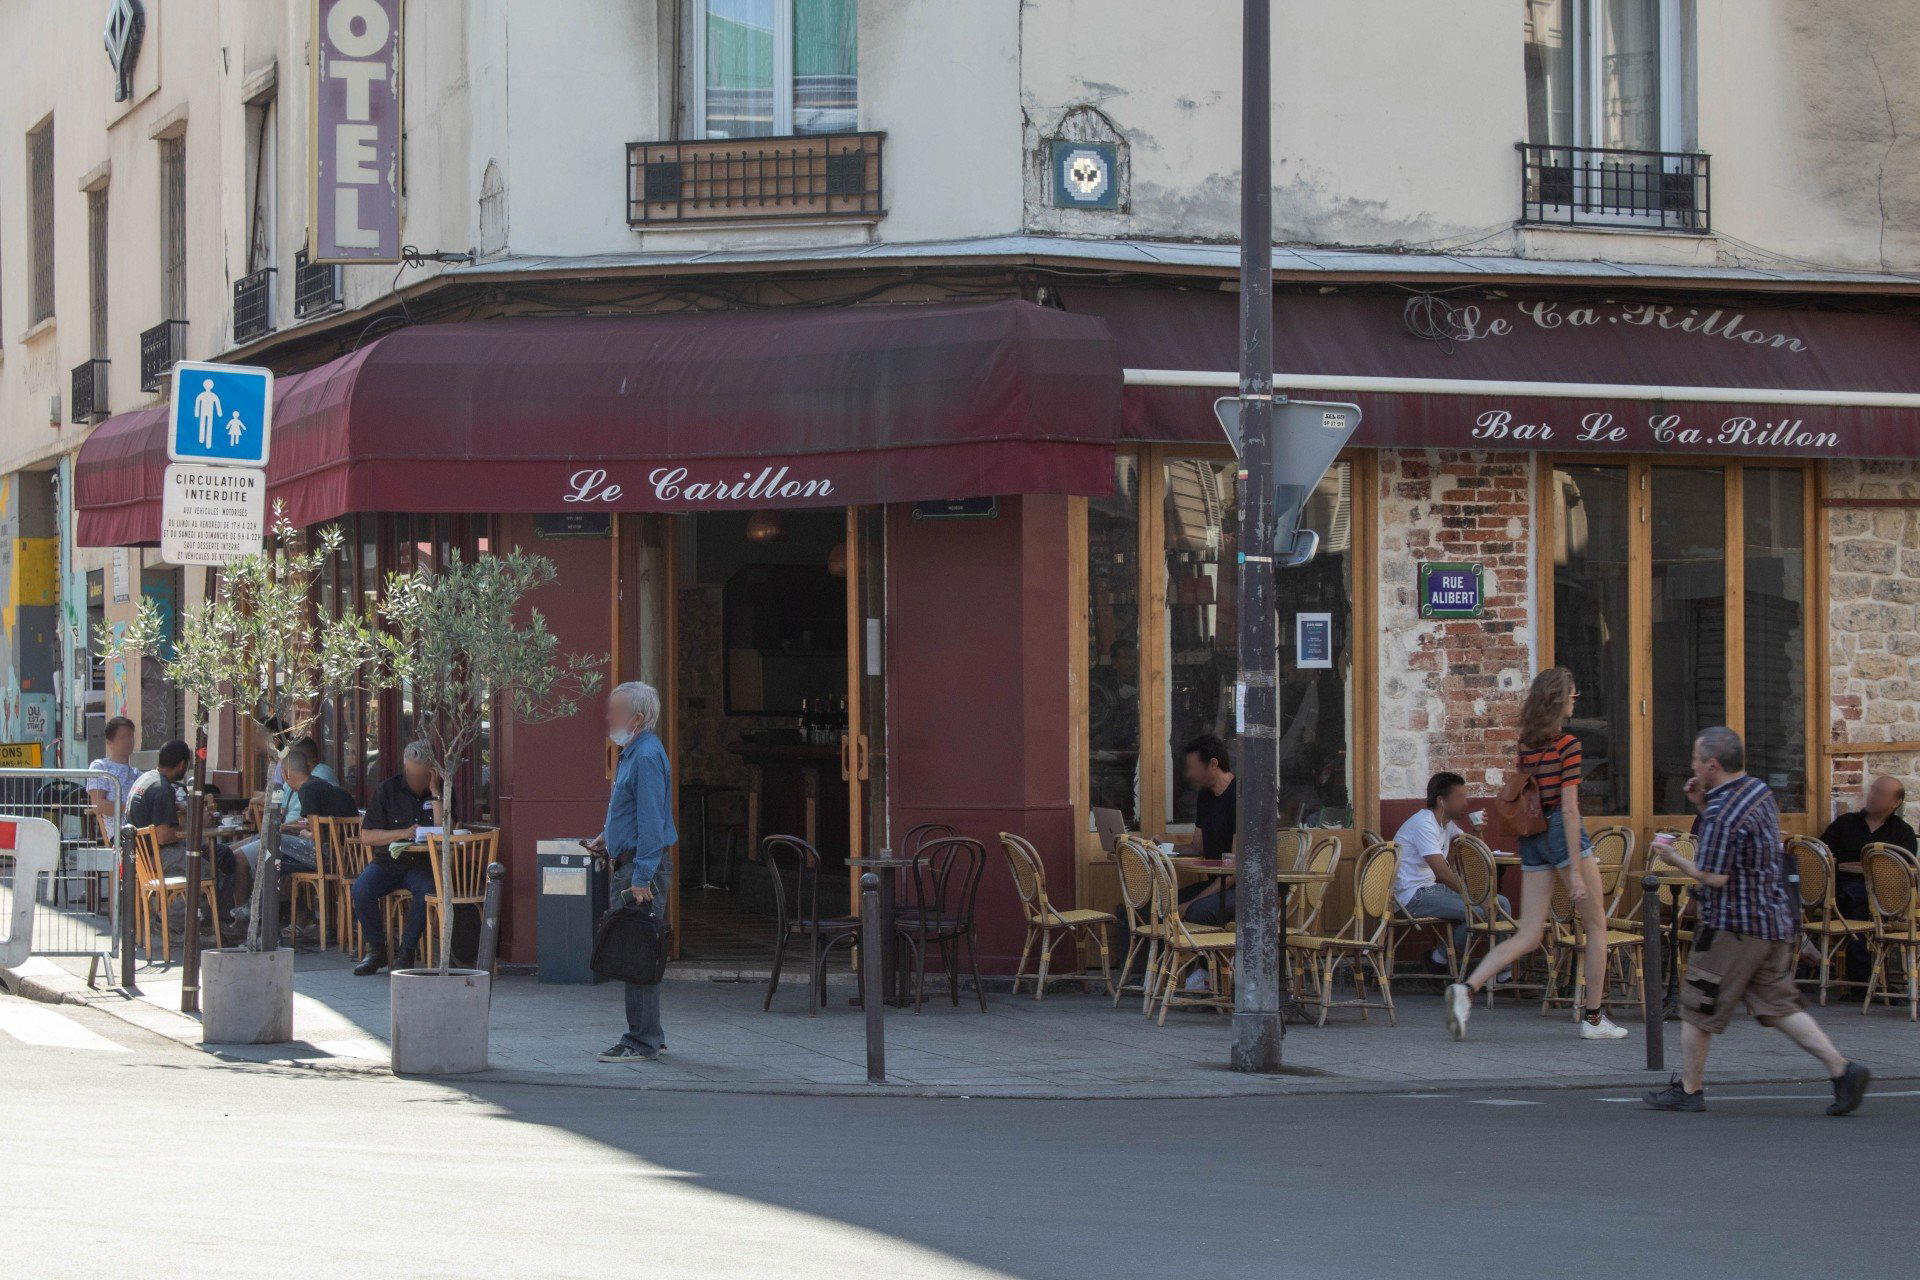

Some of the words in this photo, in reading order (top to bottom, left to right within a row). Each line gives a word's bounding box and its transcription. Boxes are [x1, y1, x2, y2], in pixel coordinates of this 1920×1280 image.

[1446, 305, 1513, 341] Le
[1471, 410, 1555, 440] Bar
[1576, 412, 1628, 442] Le
[176, 474, 255, 488] CIRCULATION
[563, 469, 623, 502] Le
[649, 466, 835, 501] Carillon
[185, 489, 247, 502] INTERDITE
[183, 506, 192, 515] AUX
[168, 518, 175, 527] DU
[176, 519, 190, 528] LUNDI
[191, 520, 198, 528] AU
[199, 520, 222, 529] VENDREDI
[223, 521, 229, 530] DE
[163, 529, 169, 538] ET
[170, 529, 177, 538] DU
[178, 530, 196, 539] SAMEDI
[197, 530, 204, 539] AU
[205, 531, 229, 540] DIMANCHE
[230, 532, 236, 540] DE
[183, 541, 196, 550] SAUF
[197, 541, 220, 550] DESSERTE
[177, 551, 183, 560] ET
[211, 552, 217, 561] DE
[1442, 576, 1464, 589] RUE
[1431, 591, 1475, 604] ALIBERT
[0, 748, 23, 758] ONS
